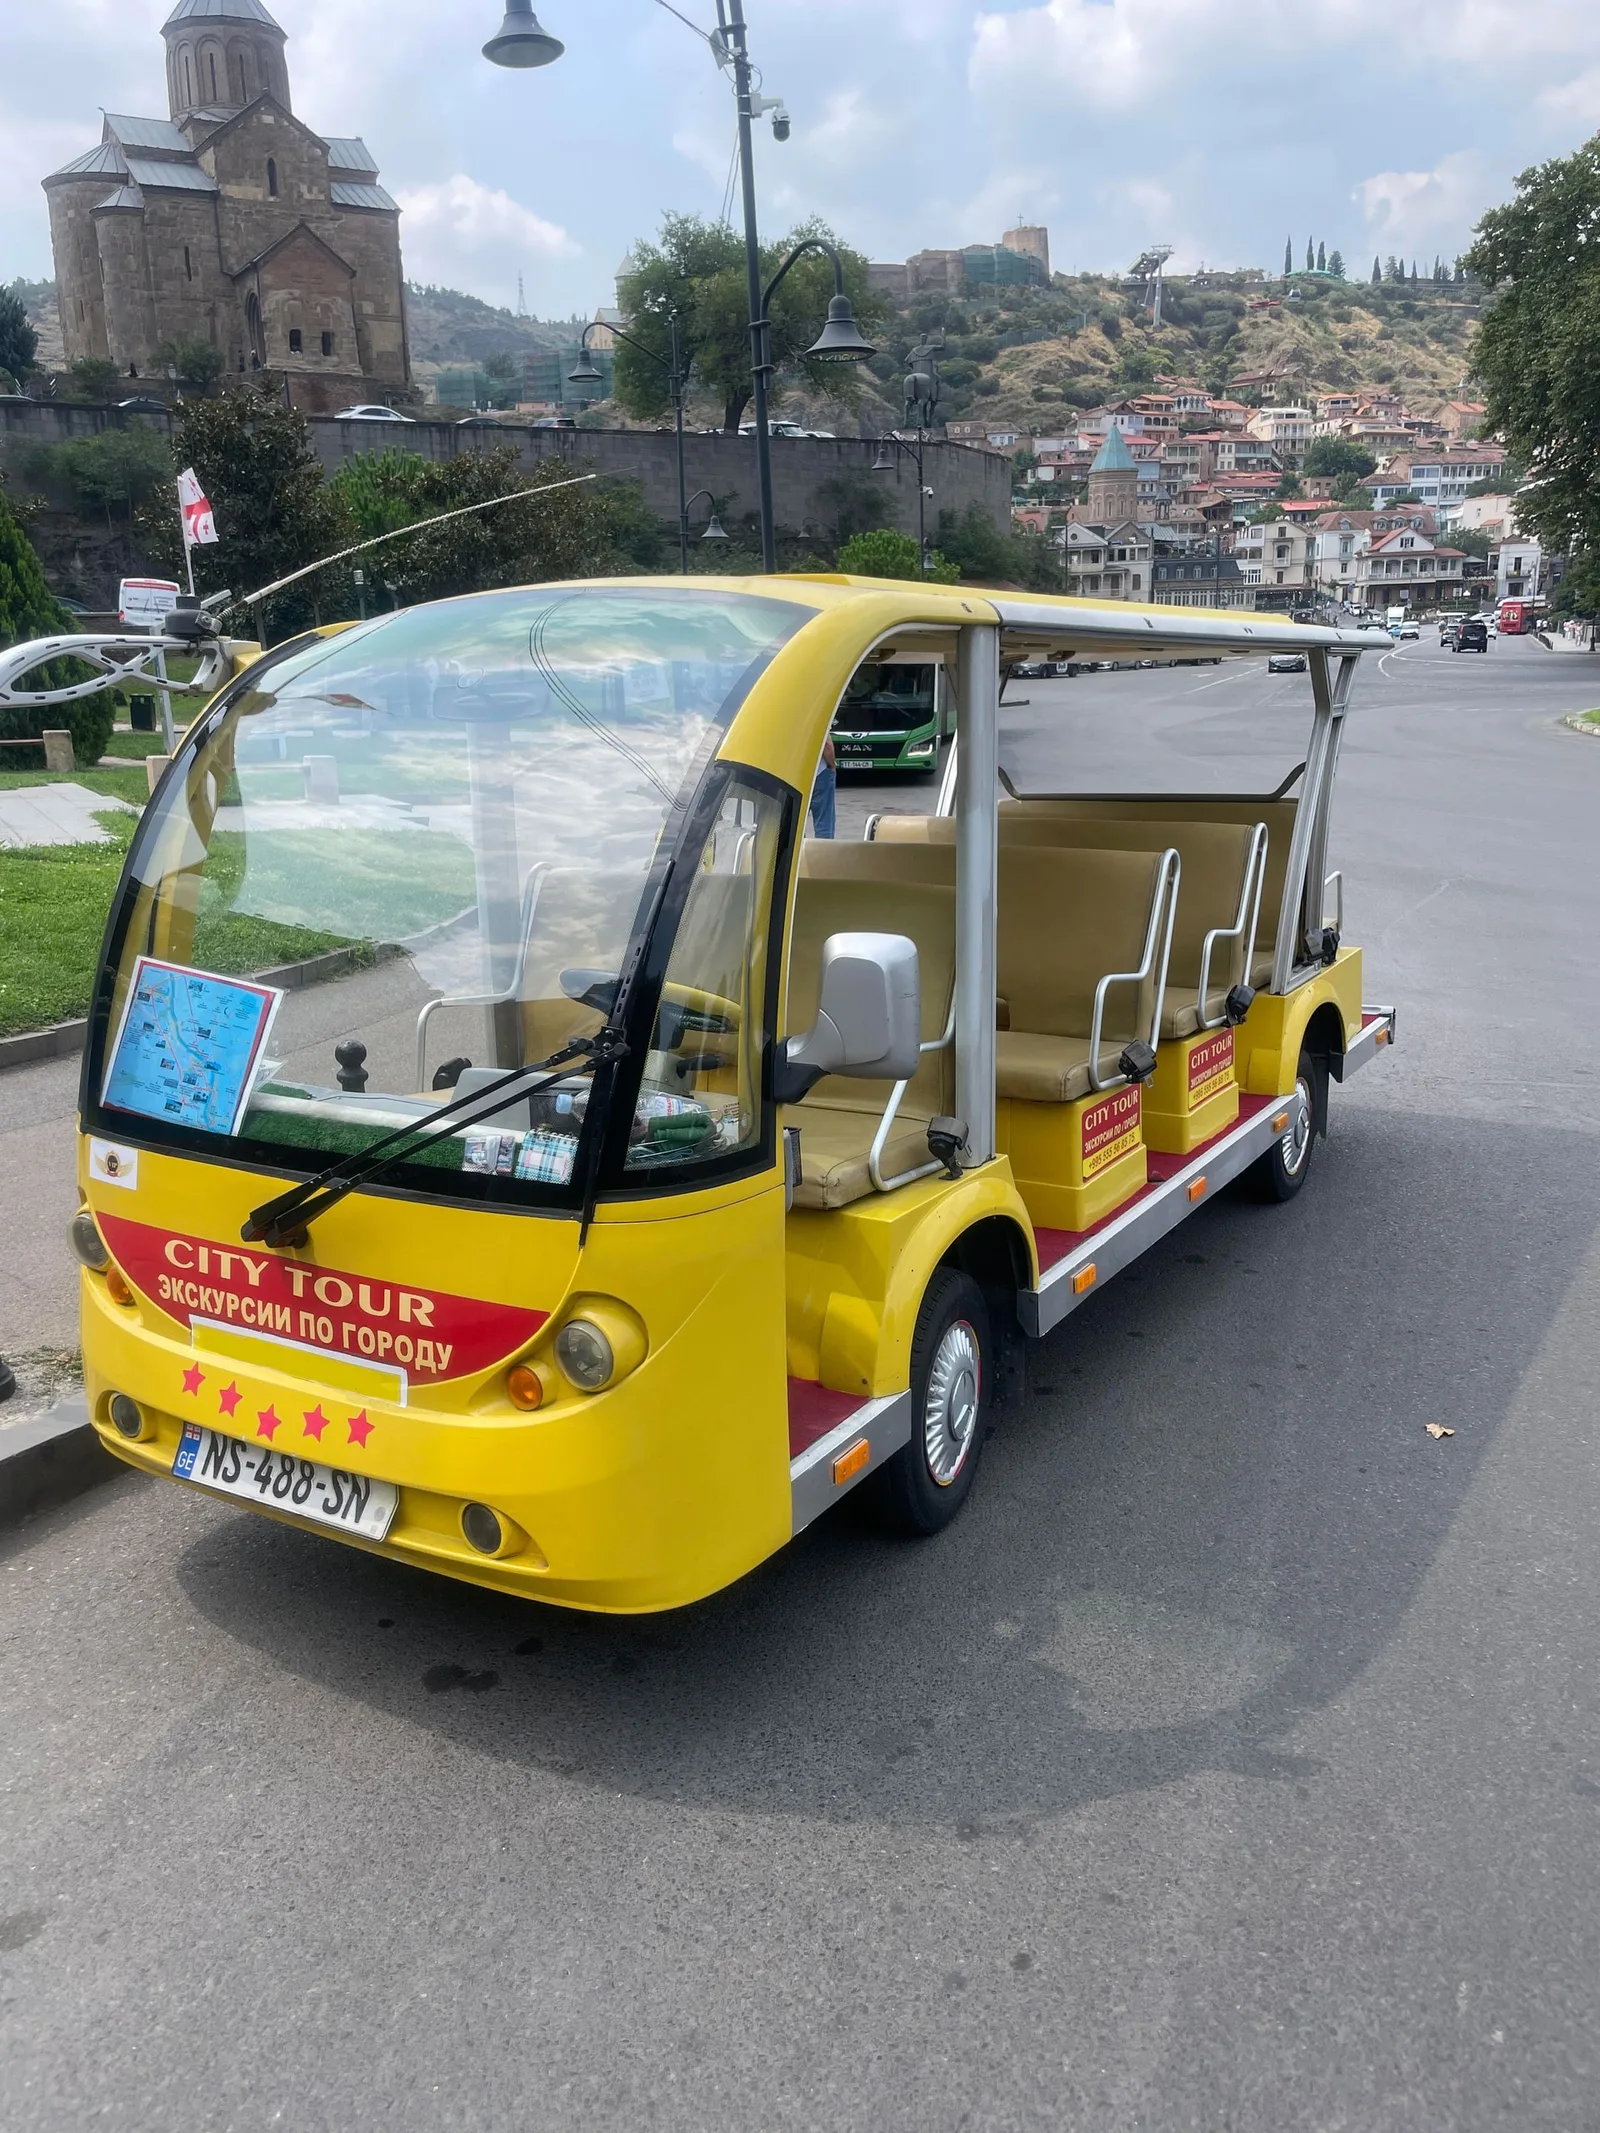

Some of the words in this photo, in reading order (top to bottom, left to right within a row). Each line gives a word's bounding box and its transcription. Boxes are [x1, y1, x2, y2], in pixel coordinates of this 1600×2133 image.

[1191, 1048, 1209, 1069] CITY
[1211, 1035, 1232, 1057] TOUR
[1085, 1105, 1109, 1130] CITY
[1112, 1090, 1138, 1116] TOUR
[1084, 1127, 1113, 1153] ЭКСКУРСИИ
[1114, 1123, 1121, 1136] ПО
[1122, 1112, 1138, 1131] ГОРОДУ
[1088, 1153, 1102, 1169] +995
[1103, 1147, 1113, 1162] 555
[1113, 1142, 1121, 1155] 56
[1128, 1132, 1135, 1144] 75
[164, 1239, 269, 1287] CITY
[284, 1266, 435, 1328] TOUR
[157, 1273, 292, 1333] ЭКСКУРСИИ
[299, 1311, 334, 1344] ПО
[342, 1321, 453, 1374] ГОРОДУ
[177, 1450, 196, 1471] GE
[201, 1431, 372, 1524] NS-488-SN
